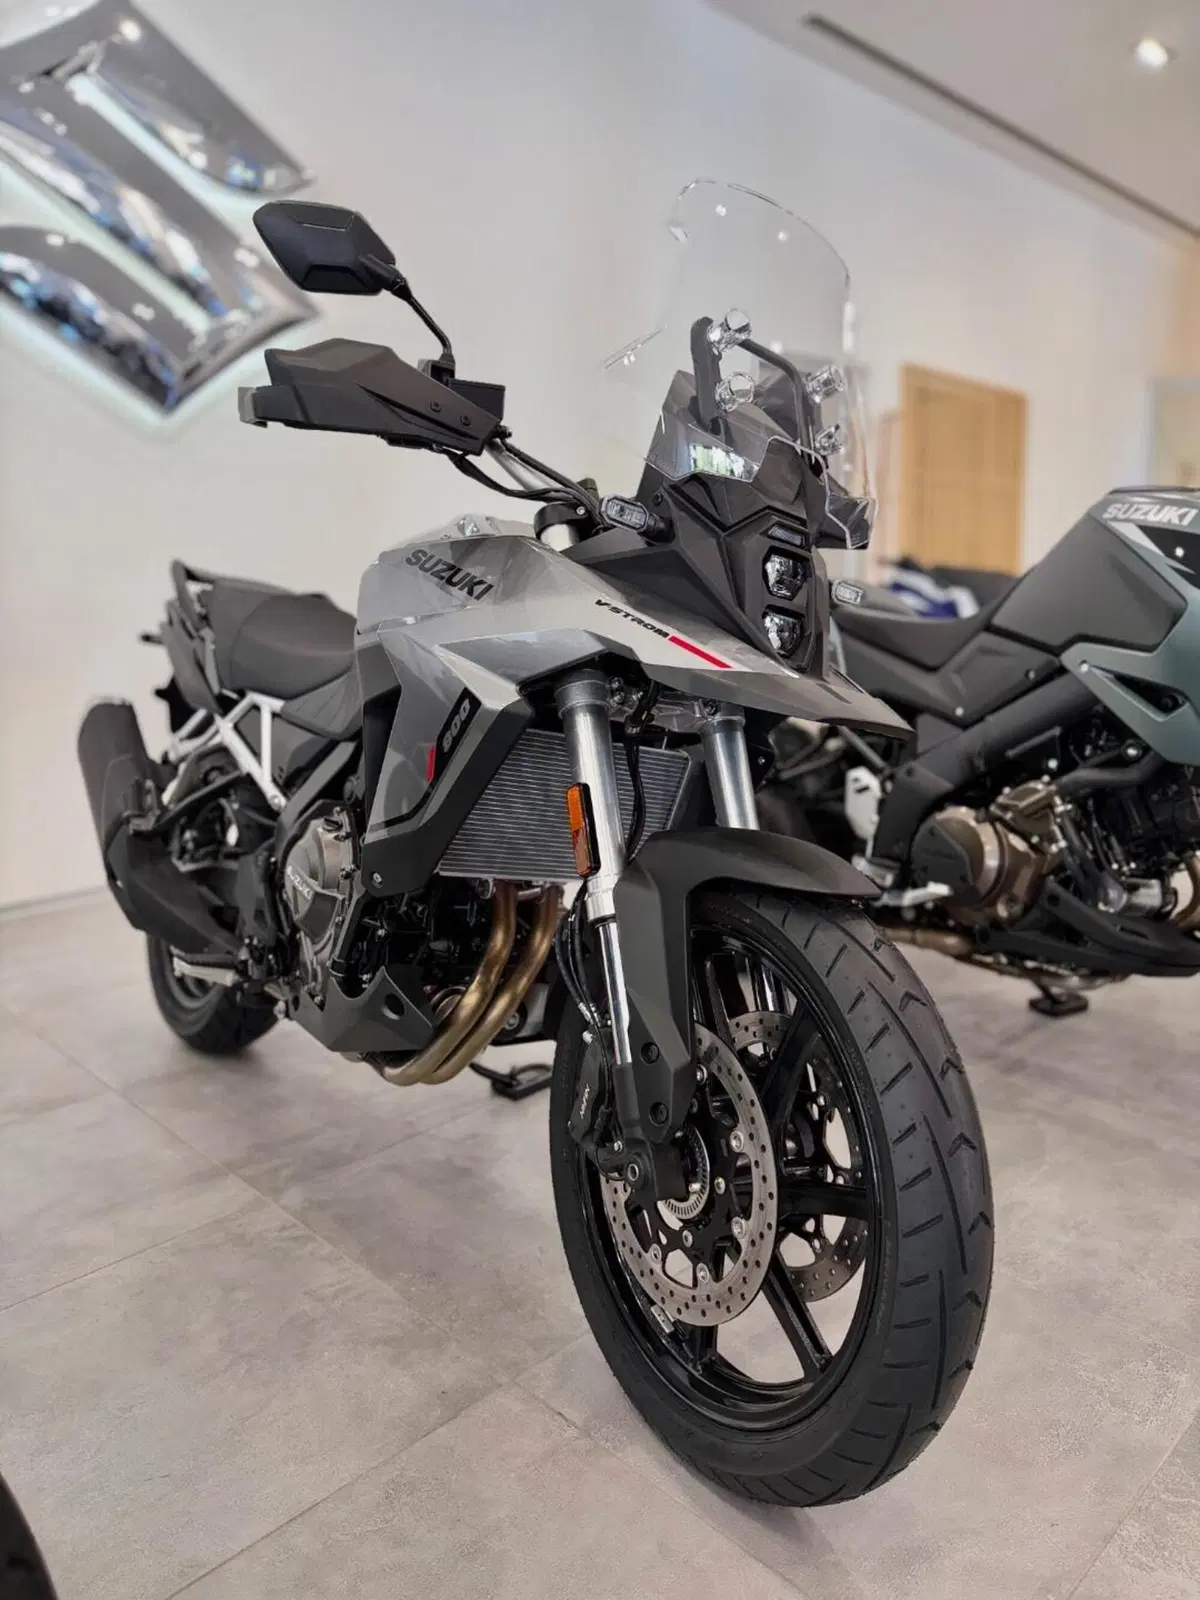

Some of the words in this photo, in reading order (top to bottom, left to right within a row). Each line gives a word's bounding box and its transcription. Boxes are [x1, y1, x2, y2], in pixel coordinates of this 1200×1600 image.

[1102, 503, 1199, 526] SUZUKI
[405, 549, 494, 600] SUZUKI
[442, 698, 471, 753] 800
